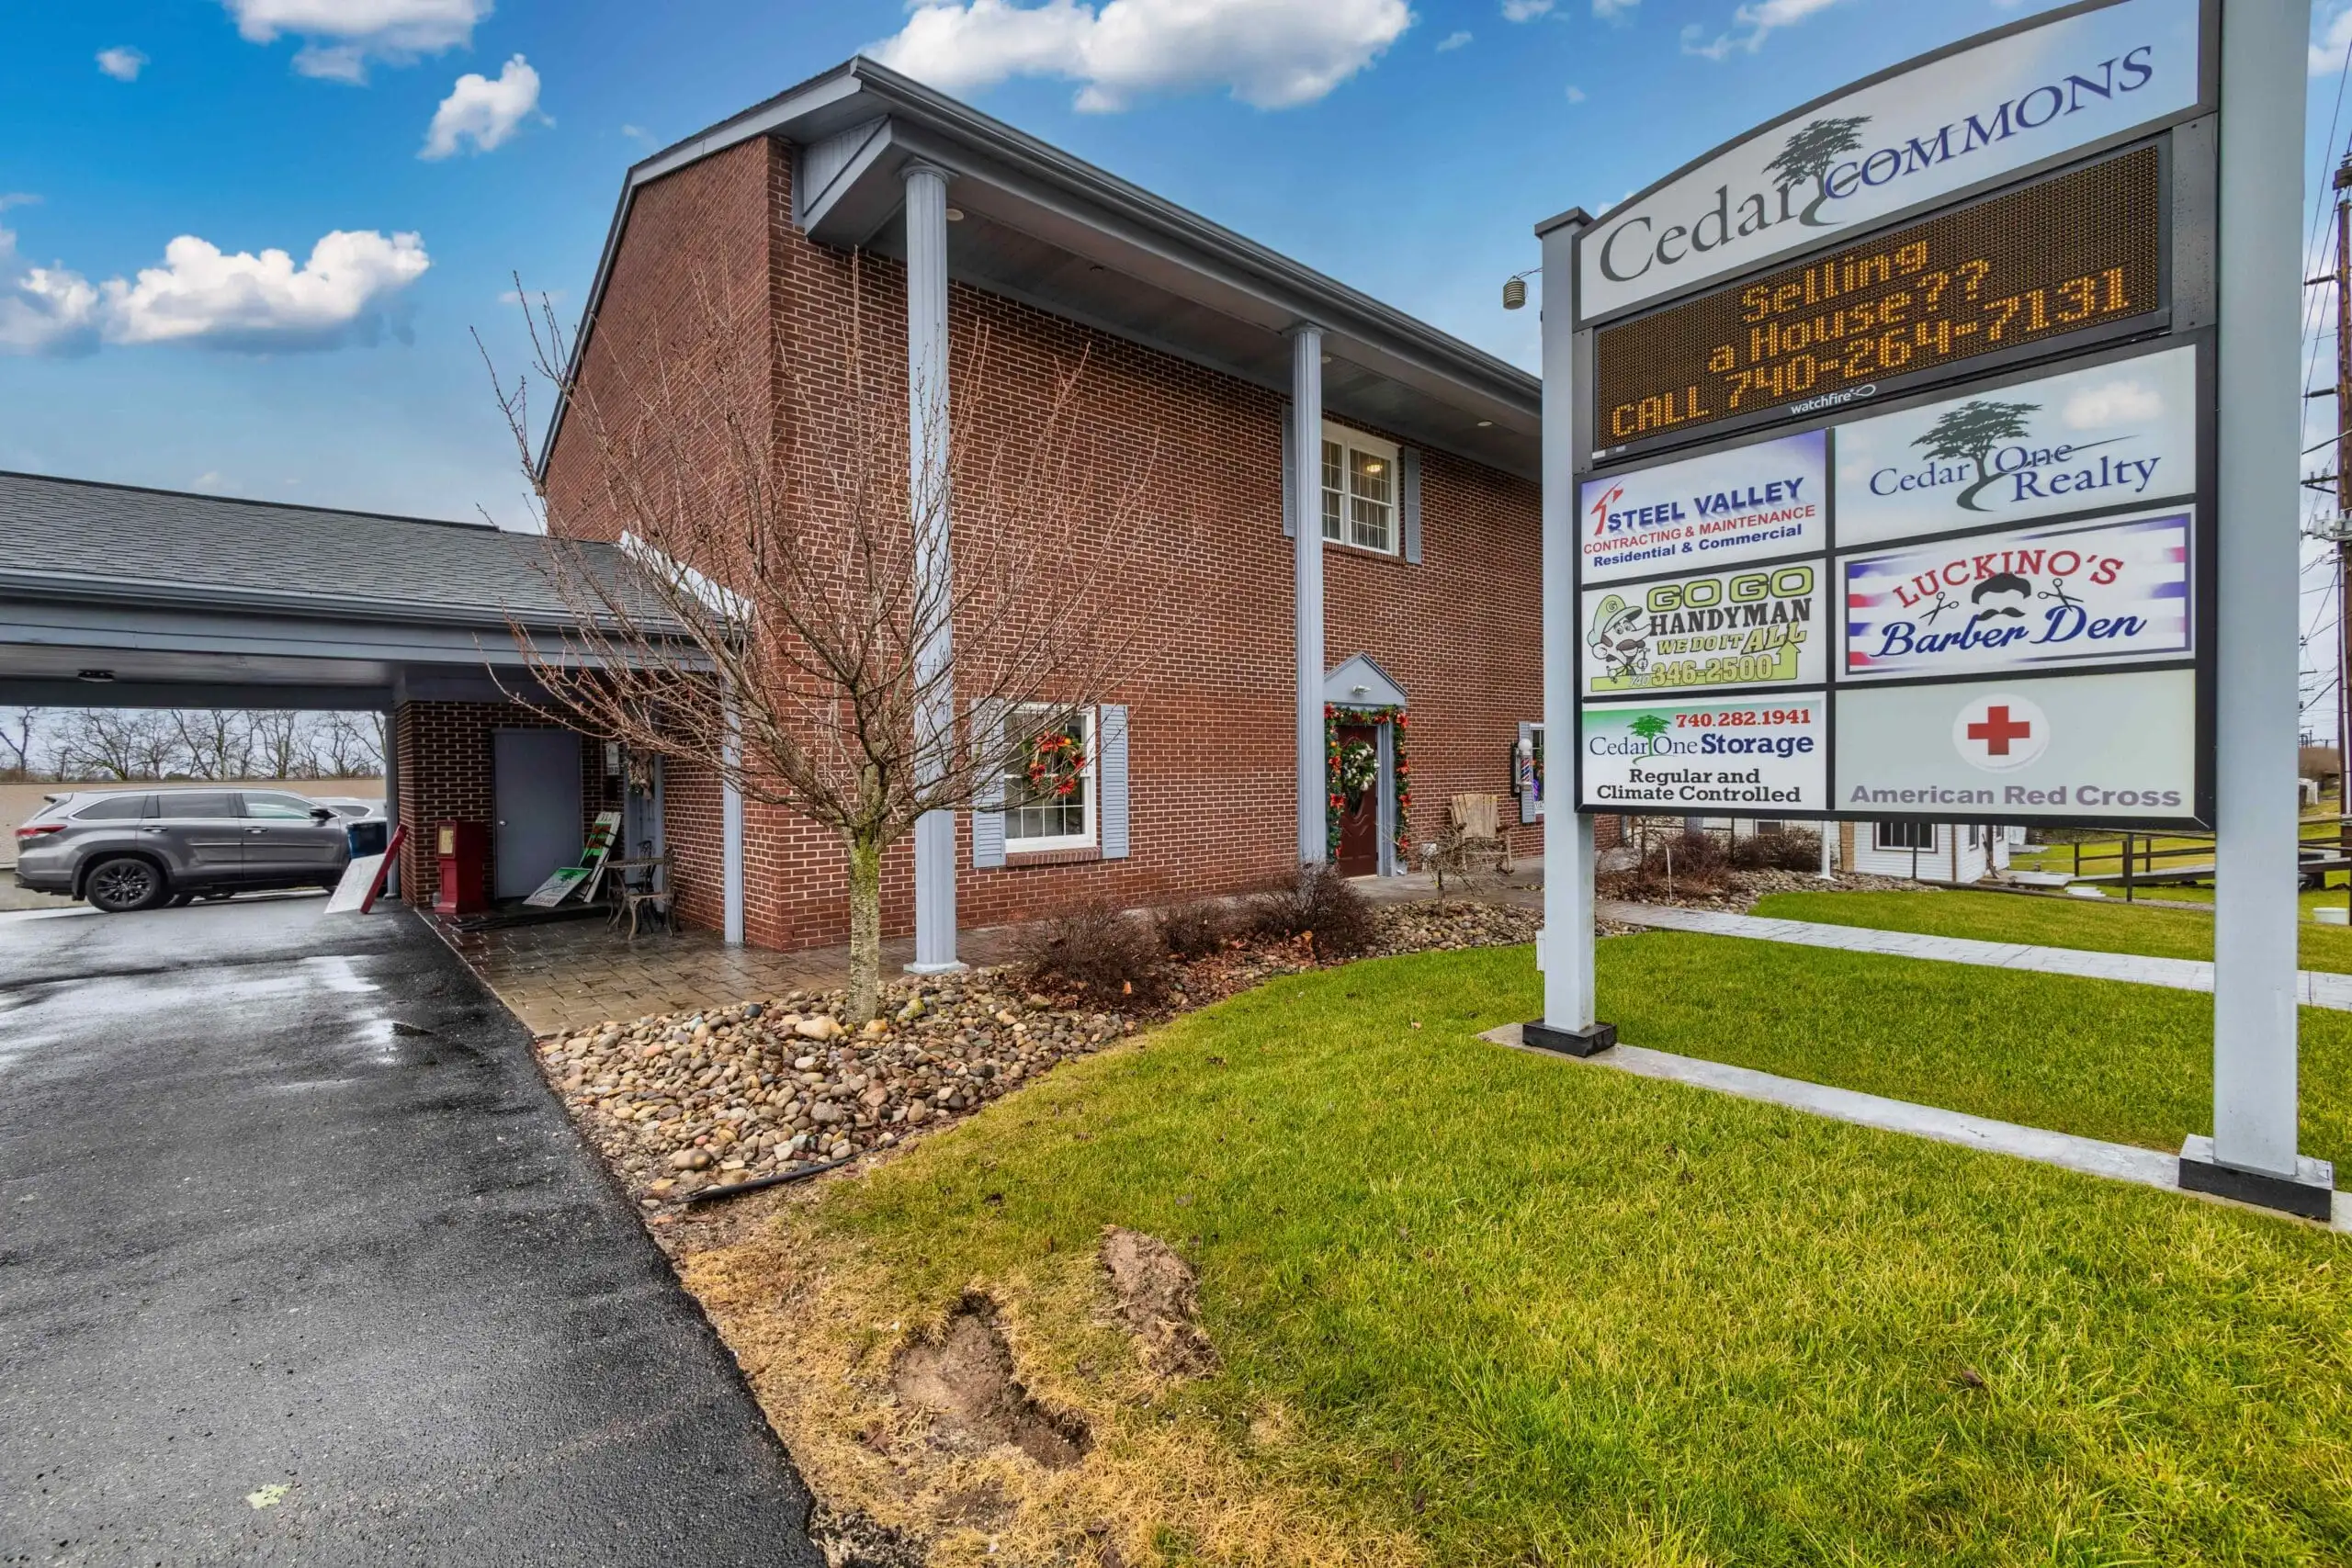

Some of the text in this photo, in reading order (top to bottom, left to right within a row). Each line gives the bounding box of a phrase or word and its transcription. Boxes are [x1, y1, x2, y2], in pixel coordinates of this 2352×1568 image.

[1600, 45, 2154, 282] Cedar COMMONS
[1743, 240, 1928, 322] Selling
[1710, 258, 1990, 373] a House??
[1612, 266, 2130, 438] CALL 740-264-7131
[1791, 392, 1851, 414] watchfire
[1869, 444, 2075, 497] Cedar One
[2010, 455, 2162, 502] Realty
[1608, 477, 1804, 532] STEEL VALLEY
[1584, 505, 1816, 555] CONTRACTING & MAINTENANCE
[1593, 524, 1803, 568] Residential & Commercial
[1646, 566, 1815, 613] GO GO
[1893, 549, 2124, 608] LUCKINO'S
[1649, 597, 1813, 637] HANDYMAN
[1657, 620, 1808, 656] WE DO IT ALL
[1869, 604, 2148, 658] Barber Den
[1630, 654, 1773, 687] 740 346-2500
[1676, 708, 1811, 728] 740.282.1941
[1589, 733, 1815, 758] Cedar One Storage
[1597, 784, 1802, 803] Climate Controlled
[1629, 769, 1760, 786] Regular and
[1849, 784, 2182, 807] American Red Cross
